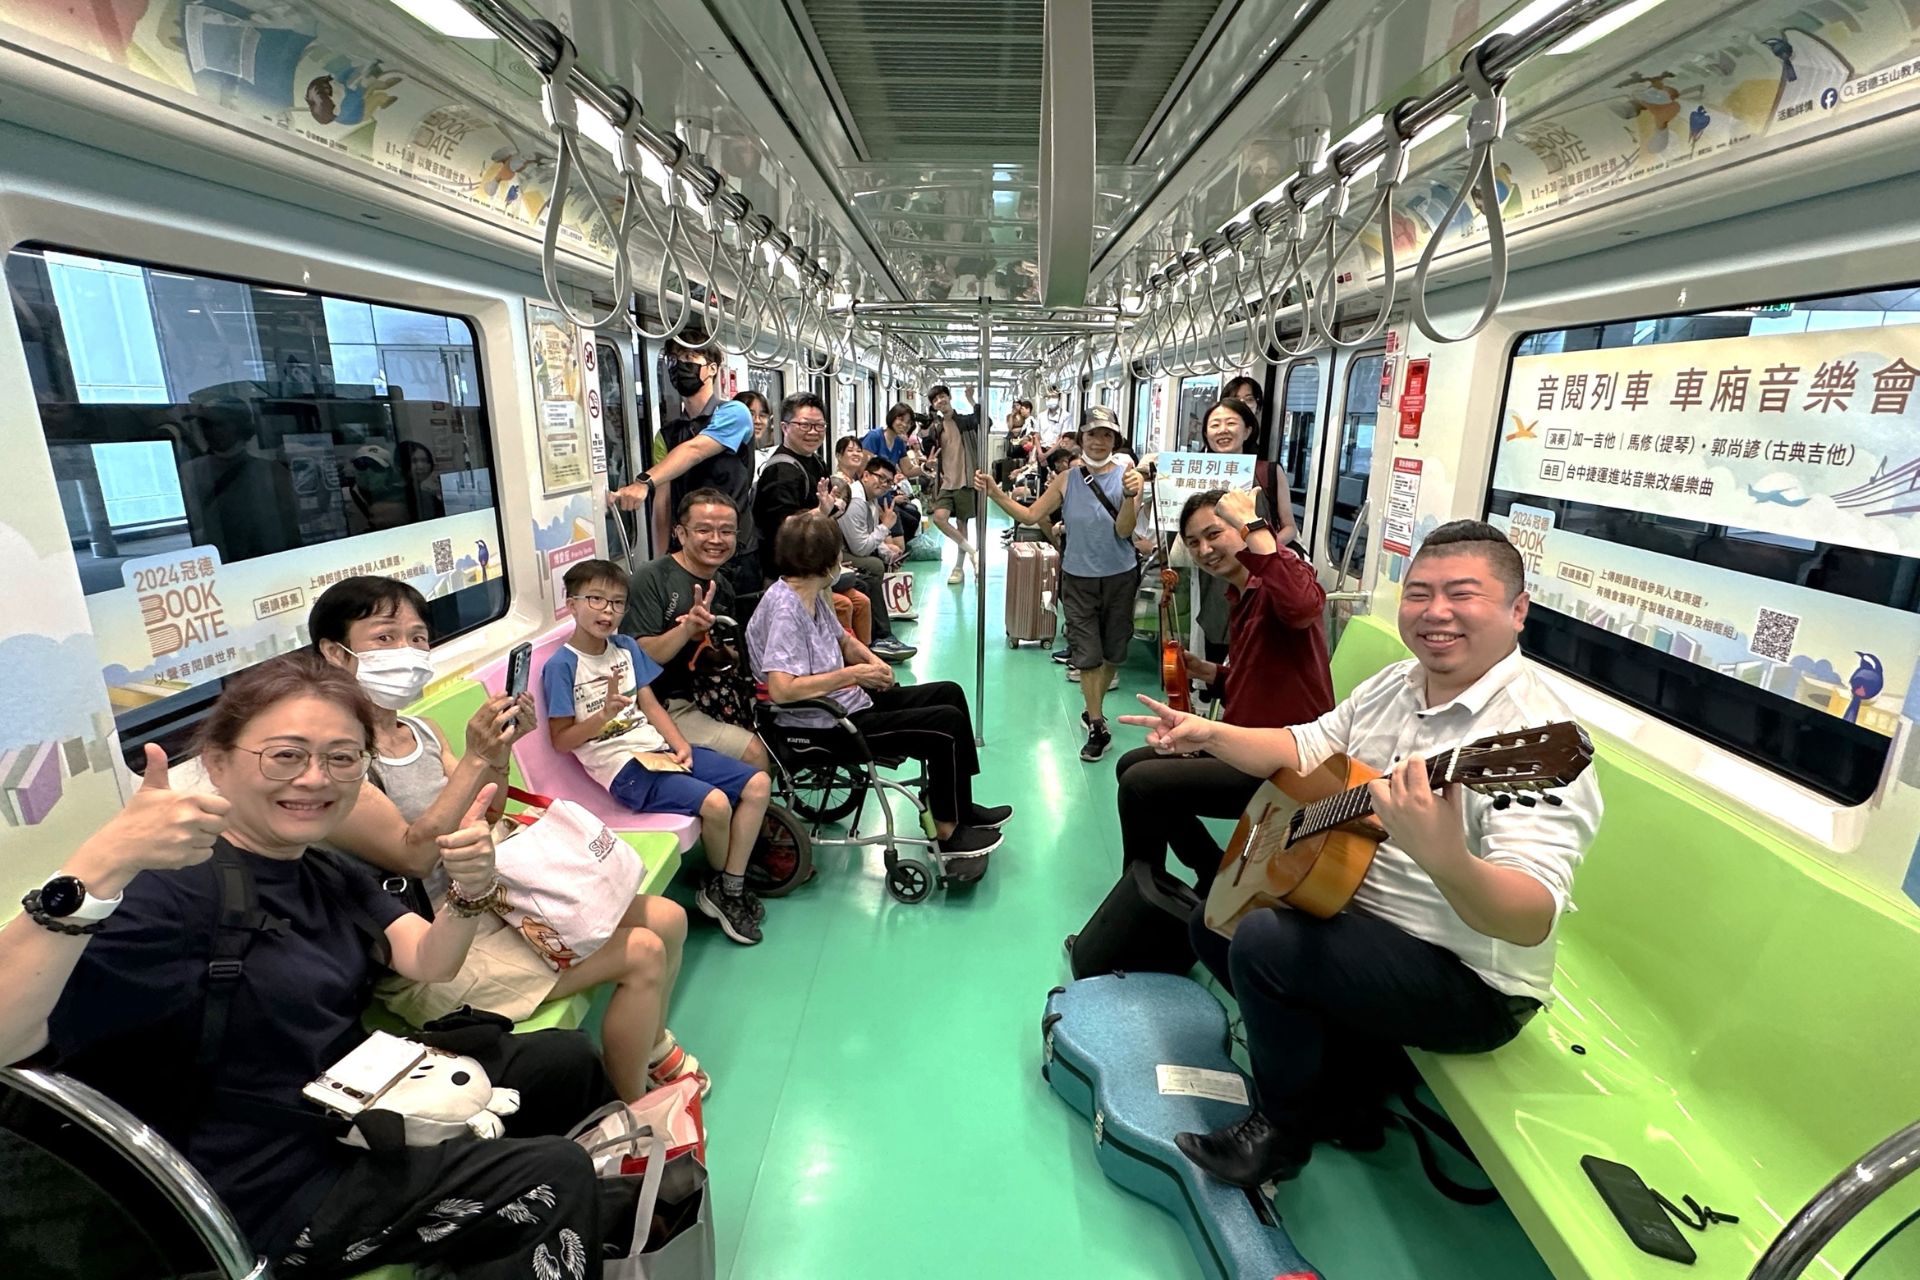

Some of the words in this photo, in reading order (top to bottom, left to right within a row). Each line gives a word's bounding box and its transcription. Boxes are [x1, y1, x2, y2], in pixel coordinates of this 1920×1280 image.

[1537, 369, 1654, 412] 音閱列車
[1669, 357, 1920, 415] 車廂音樂會
[1549, 432, 1566, 446] 演奏
[1170, 459, 1240, 476] 音閱列車
[1175, 477, 1231, 490] 車廂音樂會
[1543, 463, 1560, 477] 曲目
[1566, 464, 1715, 497] 台中捷運進站音樂改編樂曲
[1521, 551, 1543, 575] ATE
[139, 579, 222, 627] BOOK
[147, 608, 229, 658] DATE
[154, 647, 237, 686] 以聲音閱讀世界
